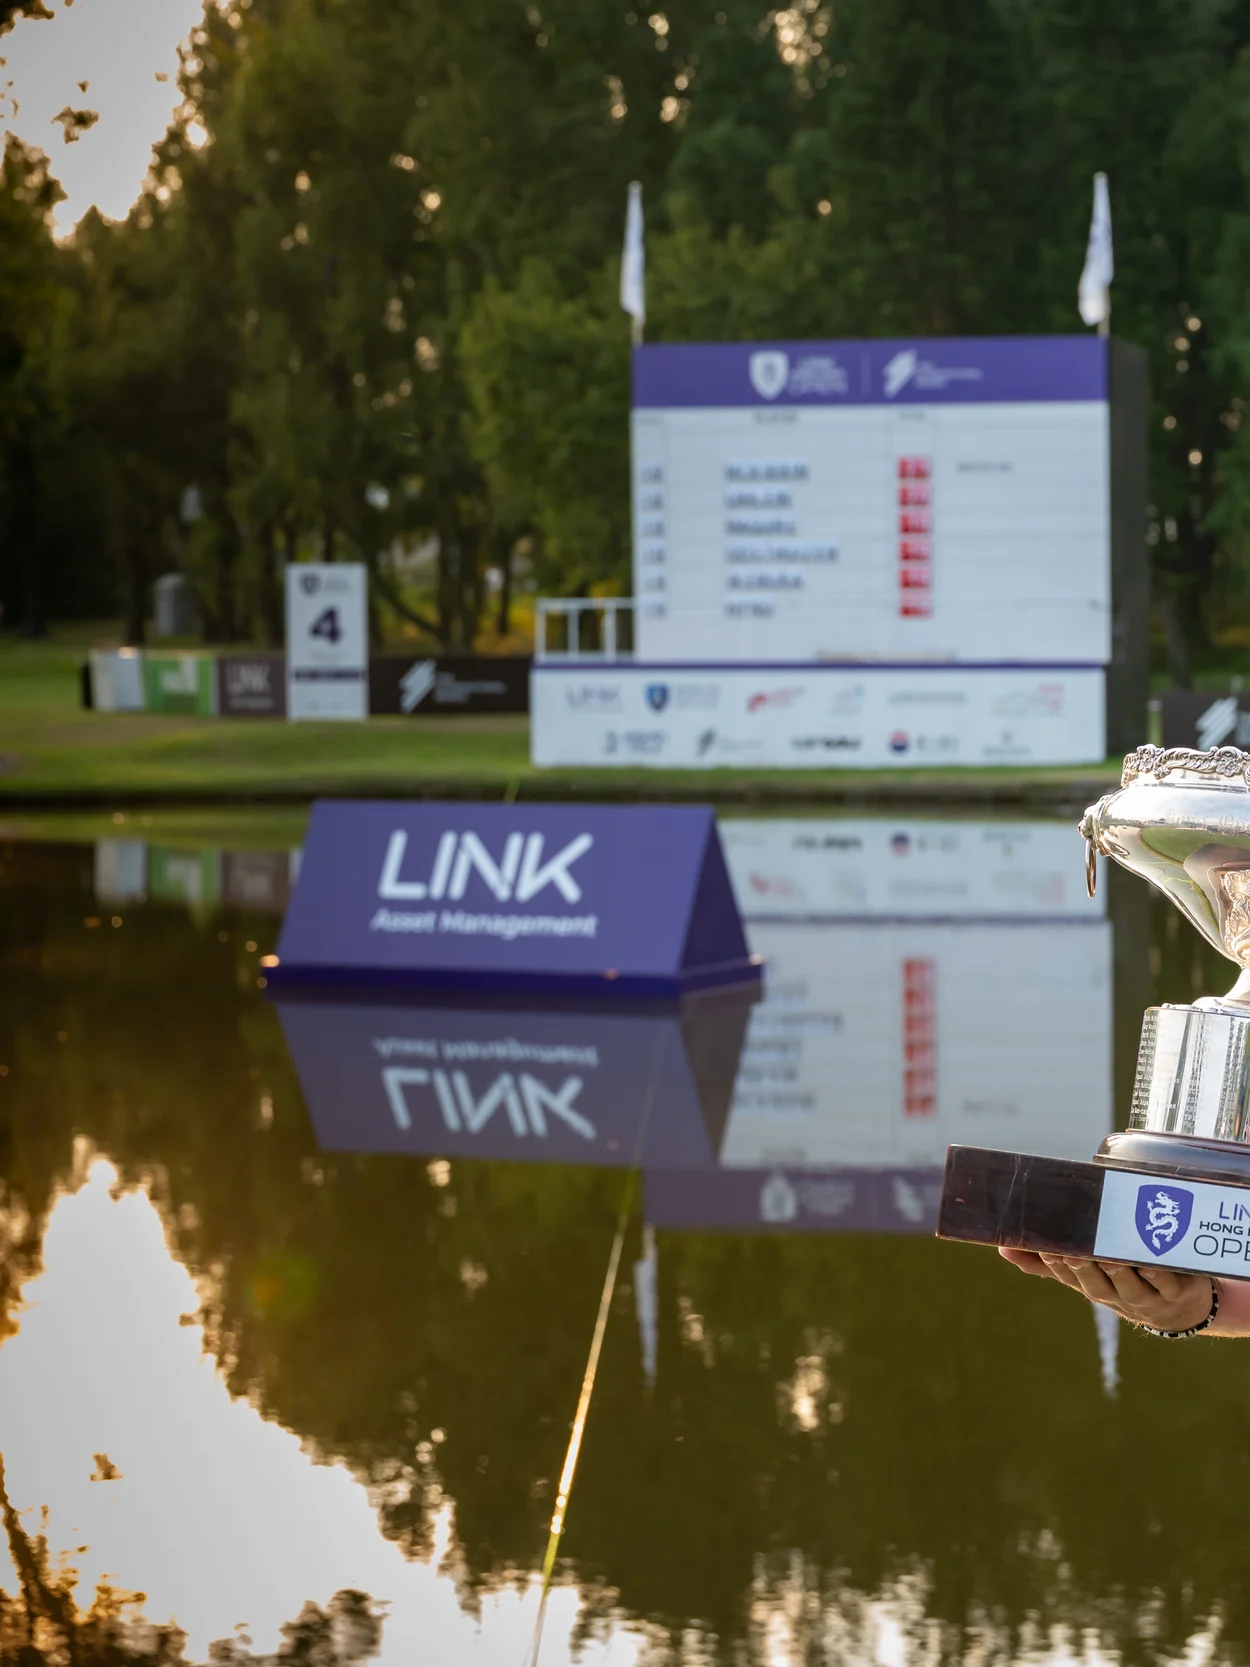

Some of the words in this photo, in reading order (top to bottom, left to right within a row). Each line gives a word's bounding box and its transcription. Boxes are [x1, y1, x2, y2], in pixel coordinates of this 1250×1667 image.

[308, 605, 343, 646] 4
[378, 828, 594, 904] LINK
[369, 907, 436, 934] Asset
[439, 909, 598, 940] Management
[1199, 1220, 1244, 1236] HONG
